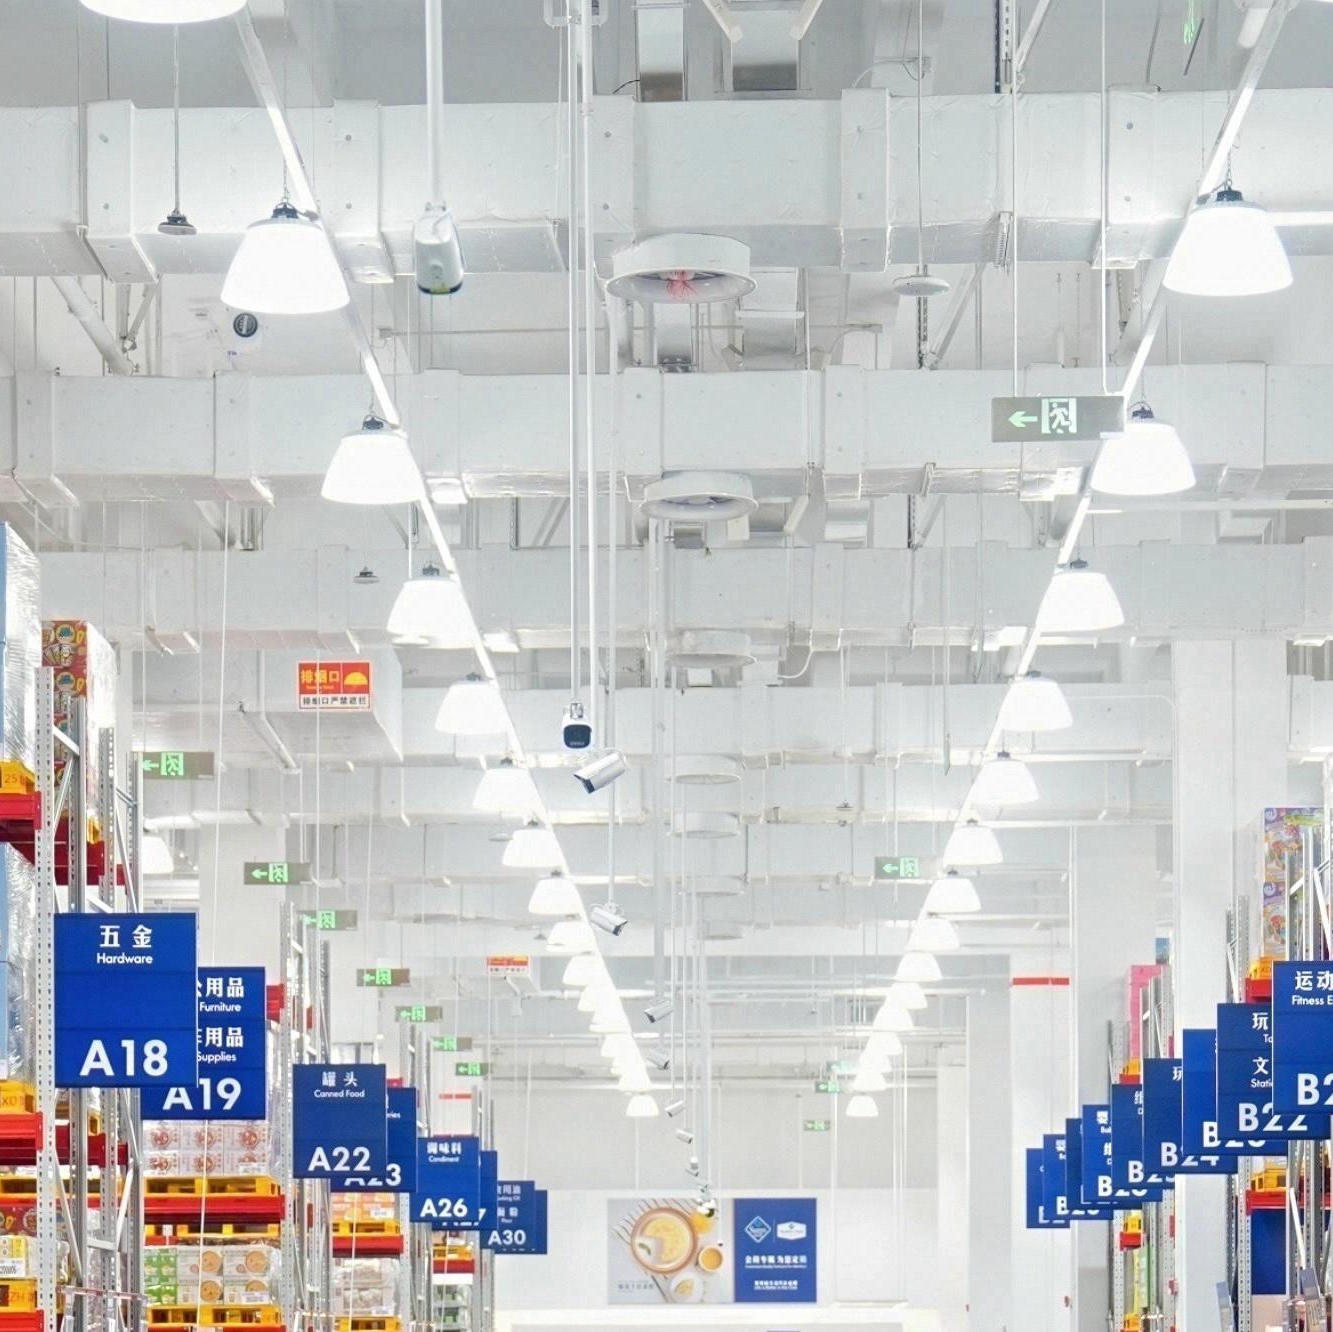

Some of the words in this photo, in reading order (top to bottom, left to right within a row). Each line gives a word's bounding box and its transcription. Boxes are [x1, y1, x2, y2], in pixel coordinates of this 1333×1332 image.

[99, 924, 153, 949] 五金
[96, 952, 154, 965] Hardware
[199, 1001, 242, 1012] Furniture
[1291, 994, 1322, 1006] Fitness
[79, 1039, 168, 1077] A18
[321, 1071, 358, 1088] 罐头
[163, 1078, 242, 1111] A19
[313, 1089, 341, 1098] Canned
[342, 1089, 365, 1098] Food
[307, 1146, 371, 1172] A22
[419, 1198, 468, 1218] A26
[487, 1229, 527, 1246] A30
